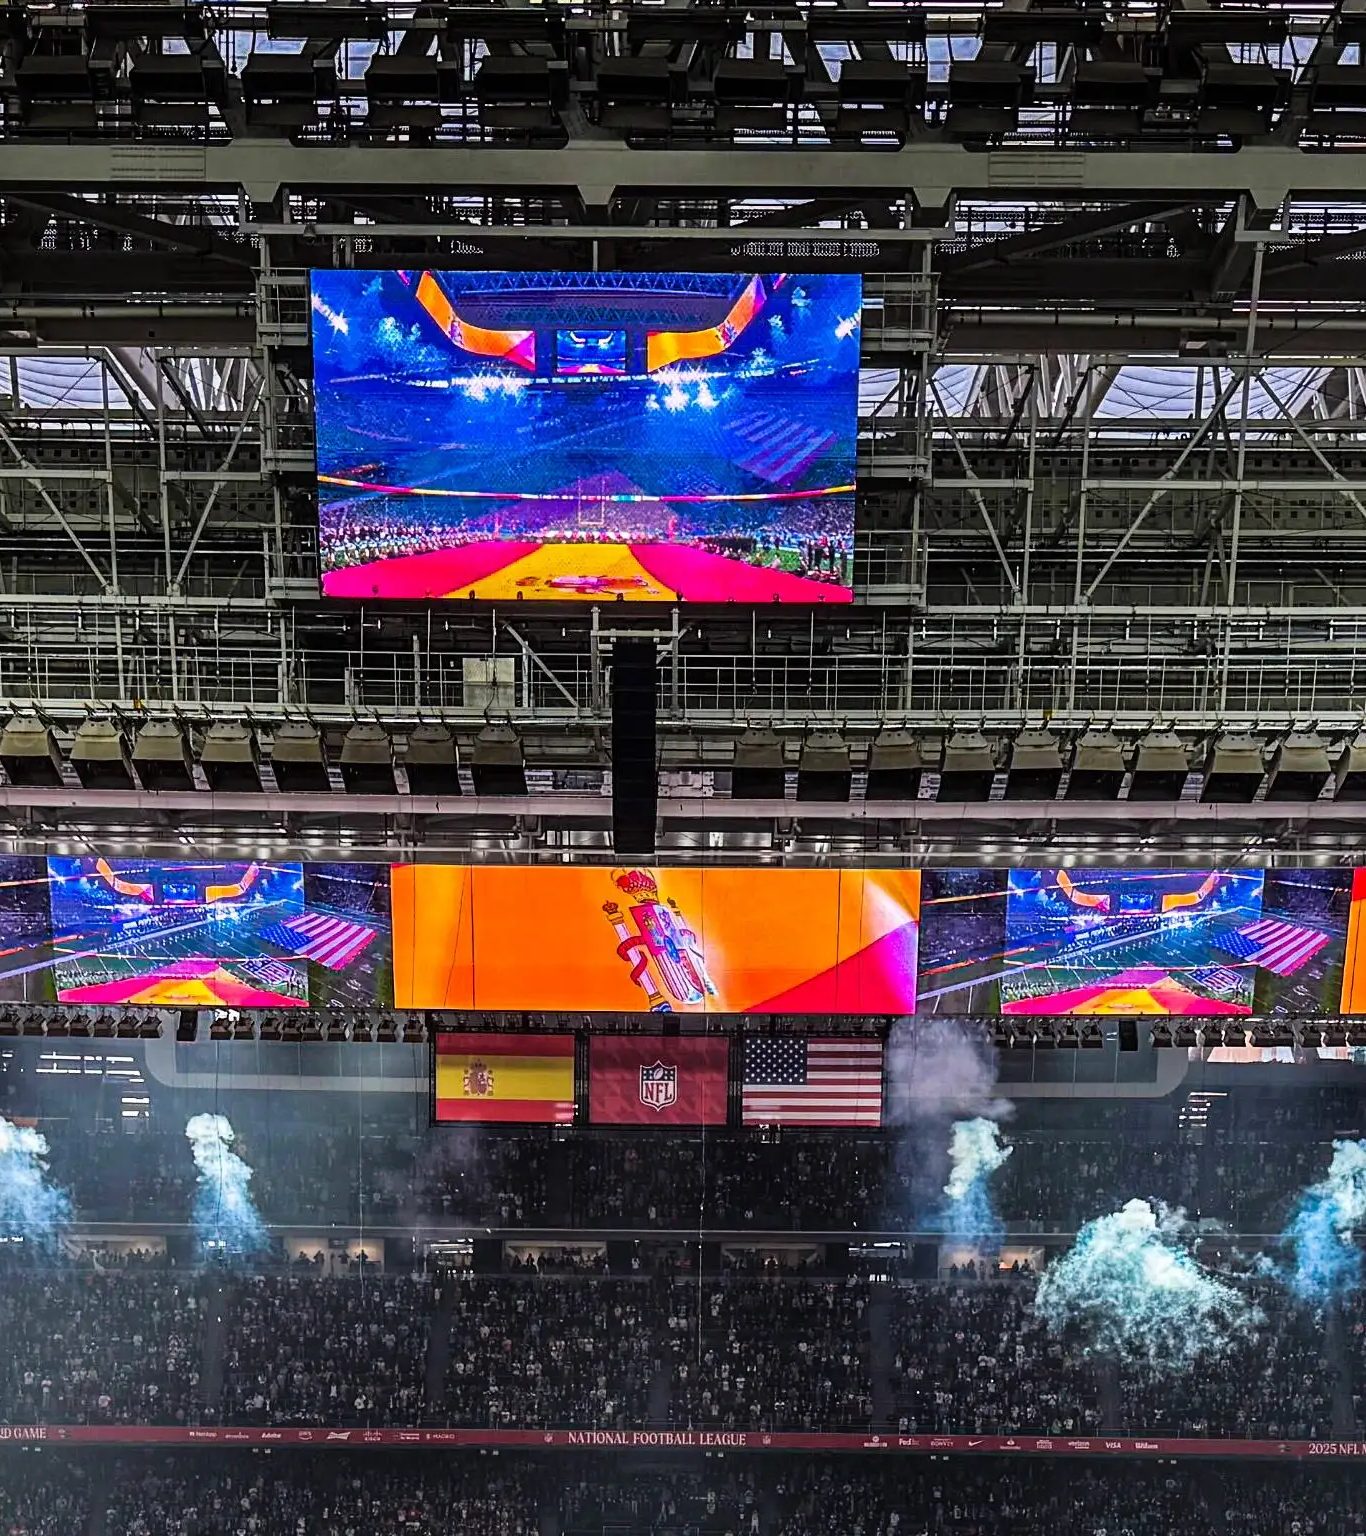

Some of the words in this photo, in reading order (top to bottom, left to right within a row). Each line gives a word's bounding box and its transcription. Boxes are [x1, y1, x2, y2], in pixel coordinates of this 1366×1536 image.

[644, 1081, 673, 1104] NFL
[14, 1427, 47, 1440] GAME
[568, 1432, 629, 1444] NATIONAL
[634, 1432, 695, 1445] FOOTBALL
[700, 1432, 747, 1446] LEAGUE
[1308, 1443, 1337, 1455] 2025
[1339, 1443, 1360, 1455] NFL
